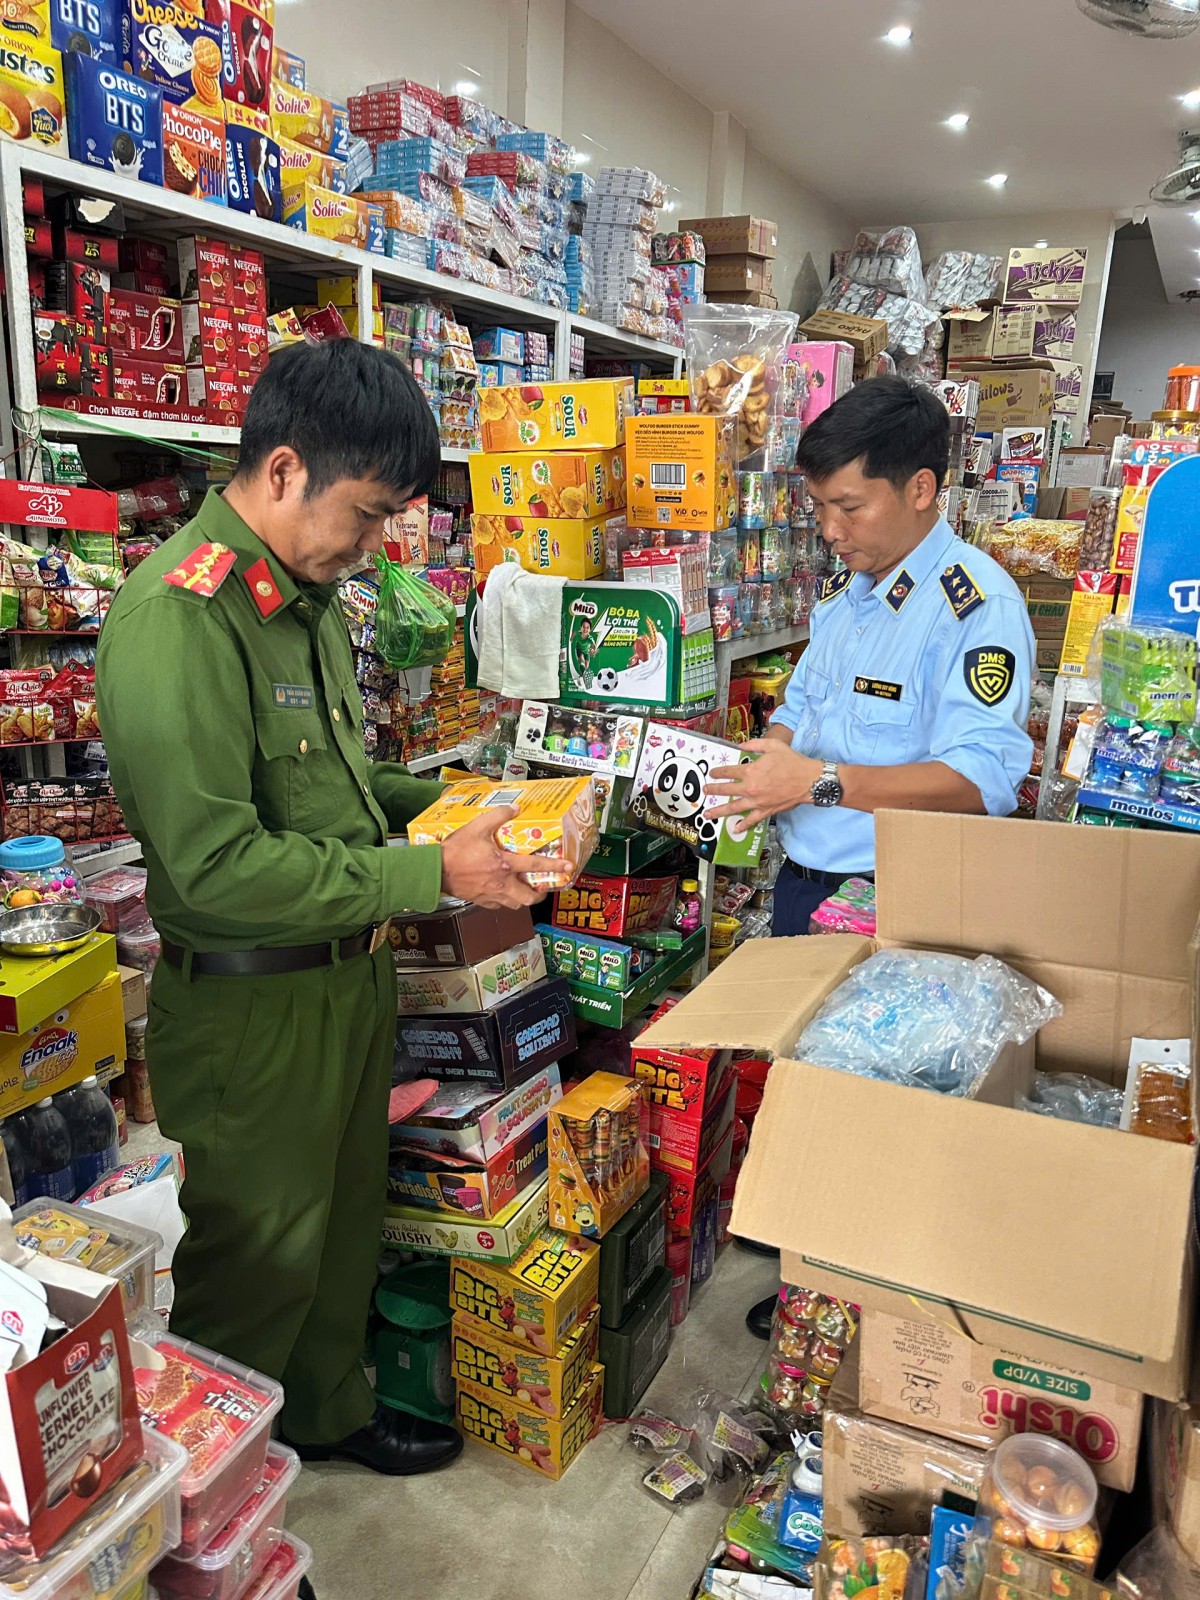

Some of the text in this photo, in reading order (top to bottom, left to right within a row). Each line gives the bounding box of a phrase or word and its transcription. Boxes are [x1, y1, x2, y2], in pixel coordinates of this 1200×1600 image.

[60, 0, 100, 36] BTS
[4, 38, 33, 54] ORION
[222, 20, 235, 83] OREO
[99, 71, 147, 99] OREO
[105, 93, 144, 135] BTS
[179, 110, 202, 124] ORION
[275, 94, 306, 115] Solite
[226, 139, 240, 199] OREO
[236, 142, 250, 200] SOCOLA PIE
[280, 149, 307, 169] Solite
[312, 200, 343, 218] Solite
[1024, 259, 1074, 285] Ticky
[561, 394, 577, 439] SOUR
[500, 464, 514, 506] SOUR
[538, 527, 551, 568] SOUR
[574, 603, 595, 614] MILO
[626, 609, 640, 618] BA
[979, 653, 1006, 664] DMS
[1111, 800, 1174, 822] mentos
[558, 888, 604, 911] BIG
[556, 910, 608, 931] BITE
[556, 942, 571, 952] MILO
[579, 948, 595, 959] MILO
[603, 954, 619, 965] MILO
[570, 993, 587, 1007] HÁT
[402, 1029, 459, 1045] GAMEPAD
[515, 1012, 560, 1047] GAMEPAD
[21, 1030, 78, 1067] Enaak
[635, 1059, 682, 1089] BIG
[516, 1152, 535, 1175] Treat
[390, 1178, 442, 1202] Paradise
[382, 1229, 432, 1246] QUISHY
[481, 1239, 492, 1248] 3+
[522, 1250, 560, 1287] BIG
[543, 1250, 583, 1291] BITE
[454, 1267, 499, 1305] BIG
[456, 1293, 510, 1331] BITE
[455, 1337, 502, 1374] BIG
[458, 1361, 514, 1397] BITE
[1003, 1364, 1079, 1395] SIZE V/DP
[38, 1371, 92, 1428] UNFLOWER
[460, 1391, 506, 1431] BIG
[462, 1416, 516, 1454] BITE
[978, 1385, 1118, 1463] Oishi
